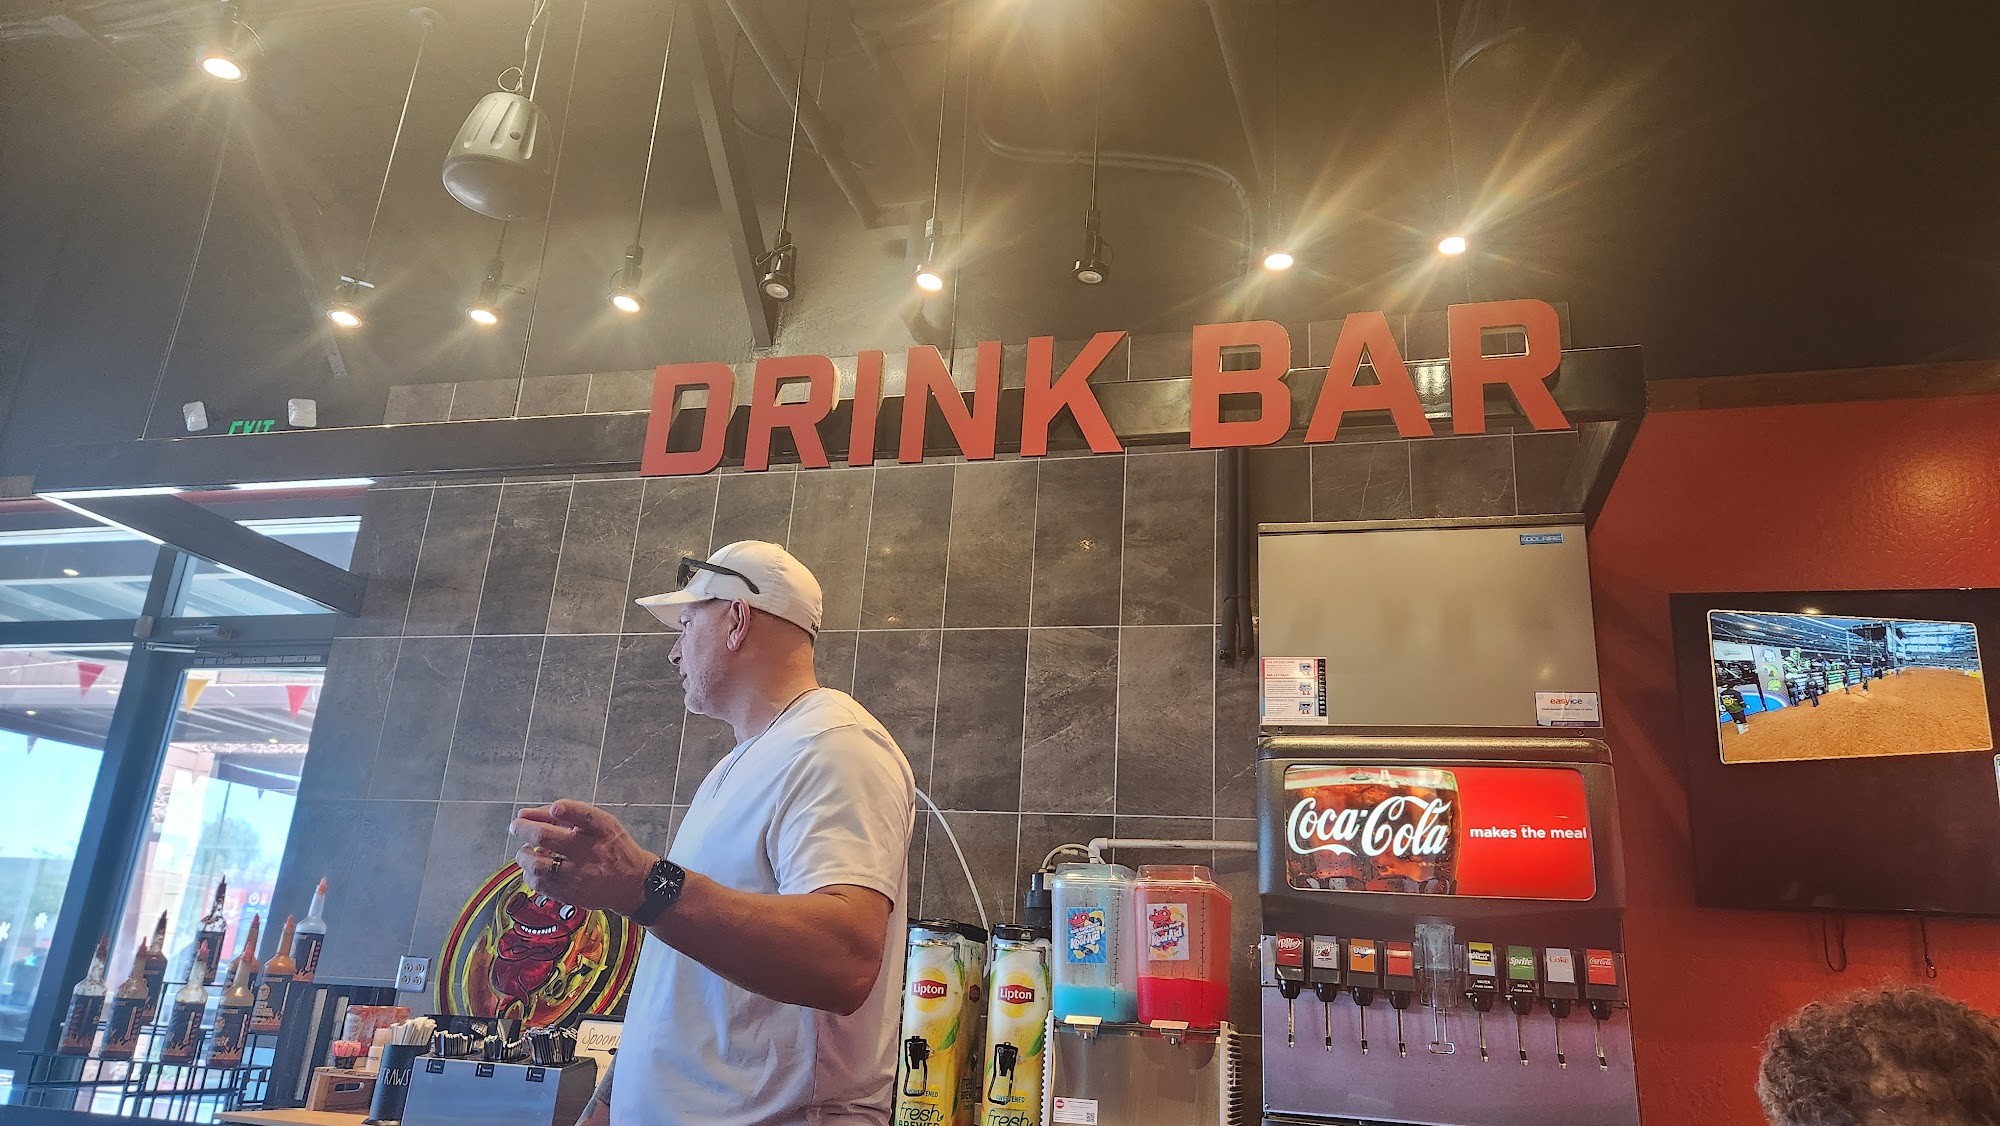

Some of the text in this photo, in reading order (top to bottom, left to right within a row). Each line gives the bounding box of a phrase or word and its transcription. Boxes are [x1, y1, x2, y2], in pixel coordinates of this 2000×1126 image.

[640, 298, 1572, 477] DRINK BAR
[1287, 796, 1452, 857] Coca-Cola
[1469, 826, 1587, 839] makes the meal
[1509, 957, 1533, 966] Sprite
[913, 983, 945, 995] Lipton
[1000, 988, 1032, 1000] Lipton
[582, 1027, 622, 1052] Spooni
[380, 1067, 411, 1086] TRAWS
[900, 1102, 942, 1121] fresh
[988, 1109, 1030, 1126] fresh
